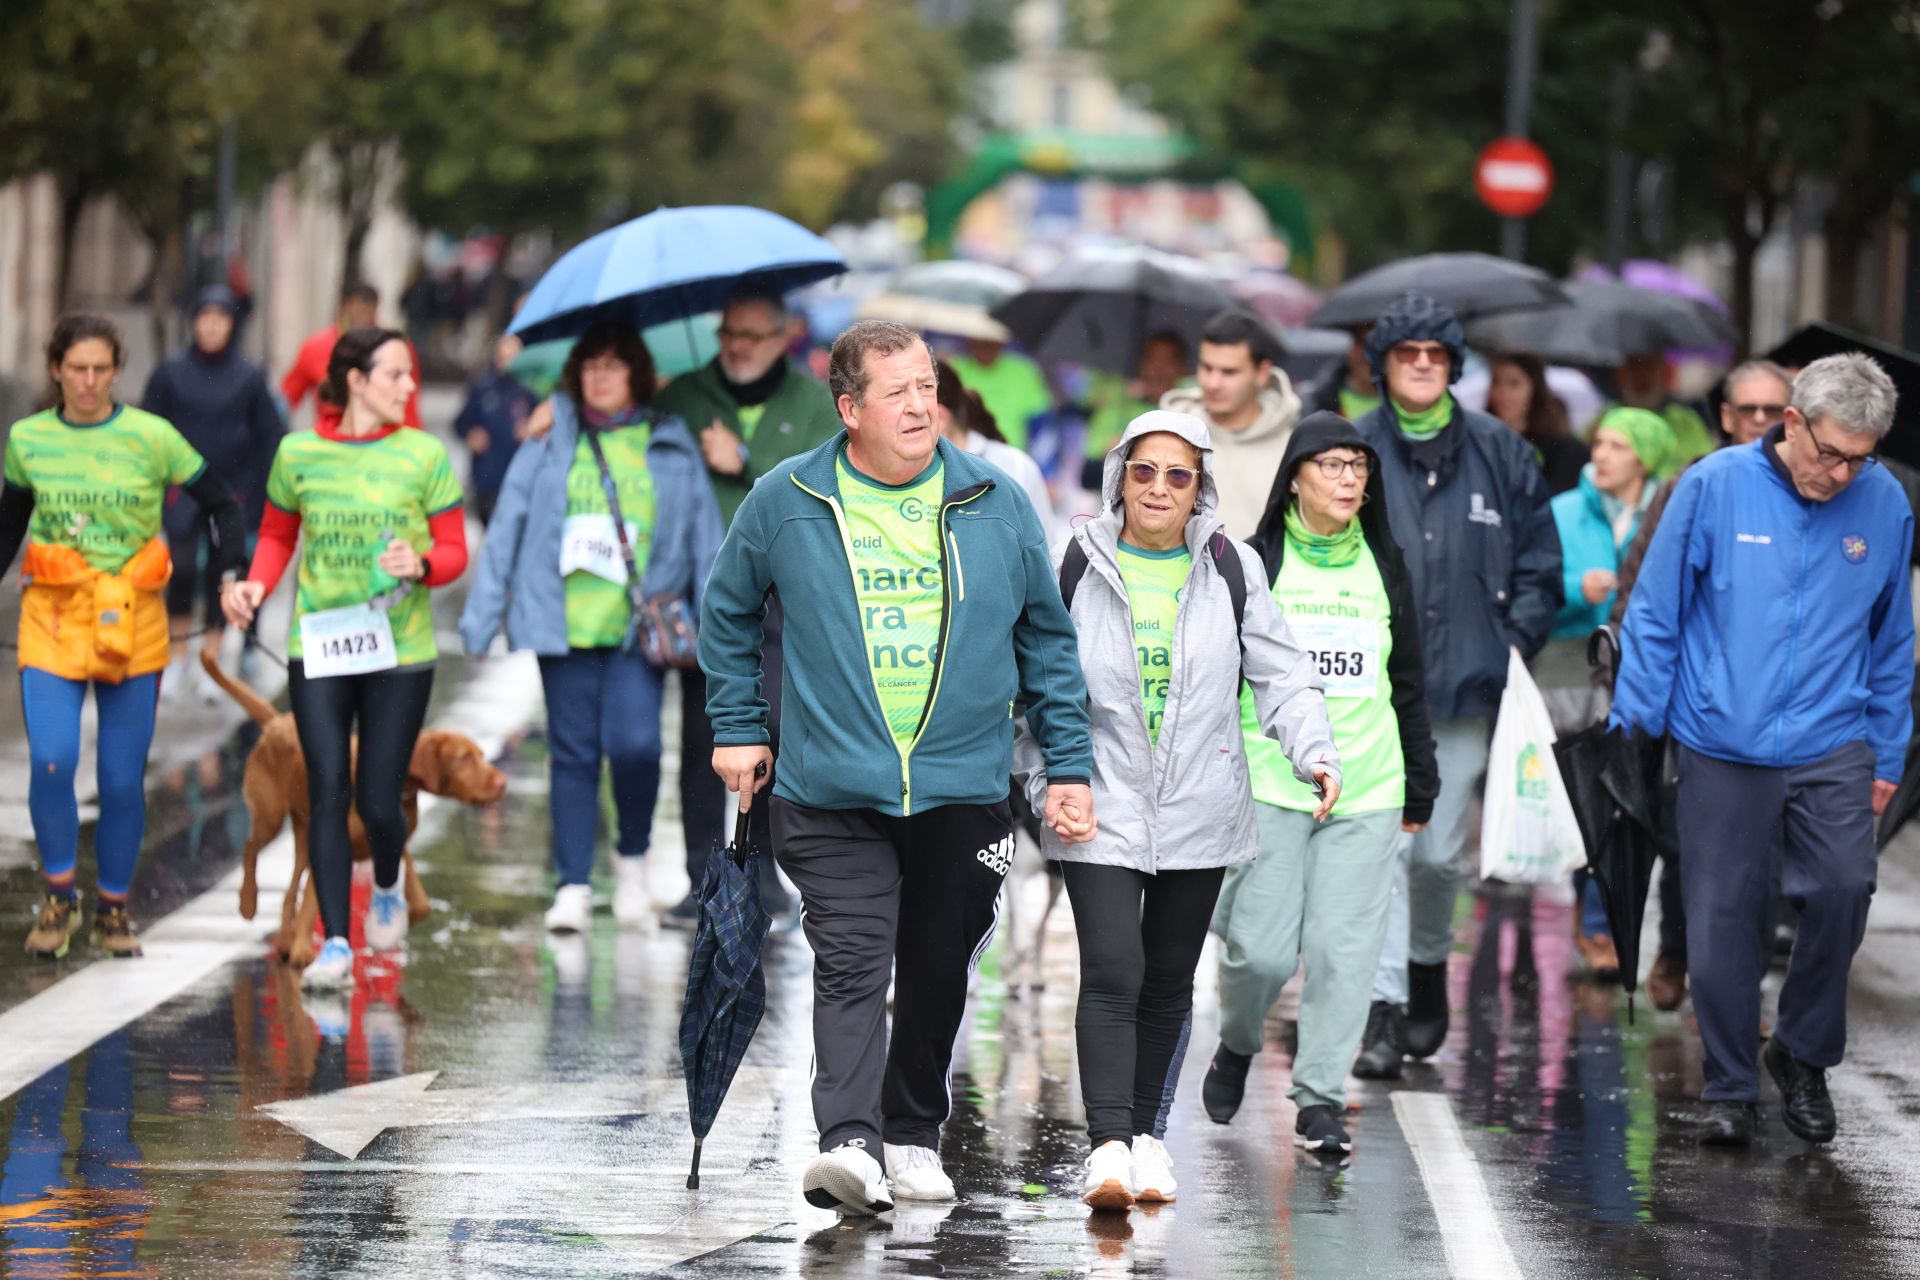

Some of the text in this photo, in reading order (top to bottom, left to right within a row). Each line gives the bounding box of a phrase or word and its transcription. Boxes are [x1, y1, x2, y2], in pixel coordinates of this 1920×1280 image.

[325, 508, 409, 528] marcha
[857, 560, 944, 592] arc
[865, 606, 907, 630] ra
[1290, 602, 1360, 618] marcha
[1135, 619, 1160, 630] olid
[322, 631, 378, 658] 14423
[1307, 650, 1364, 676] 553
